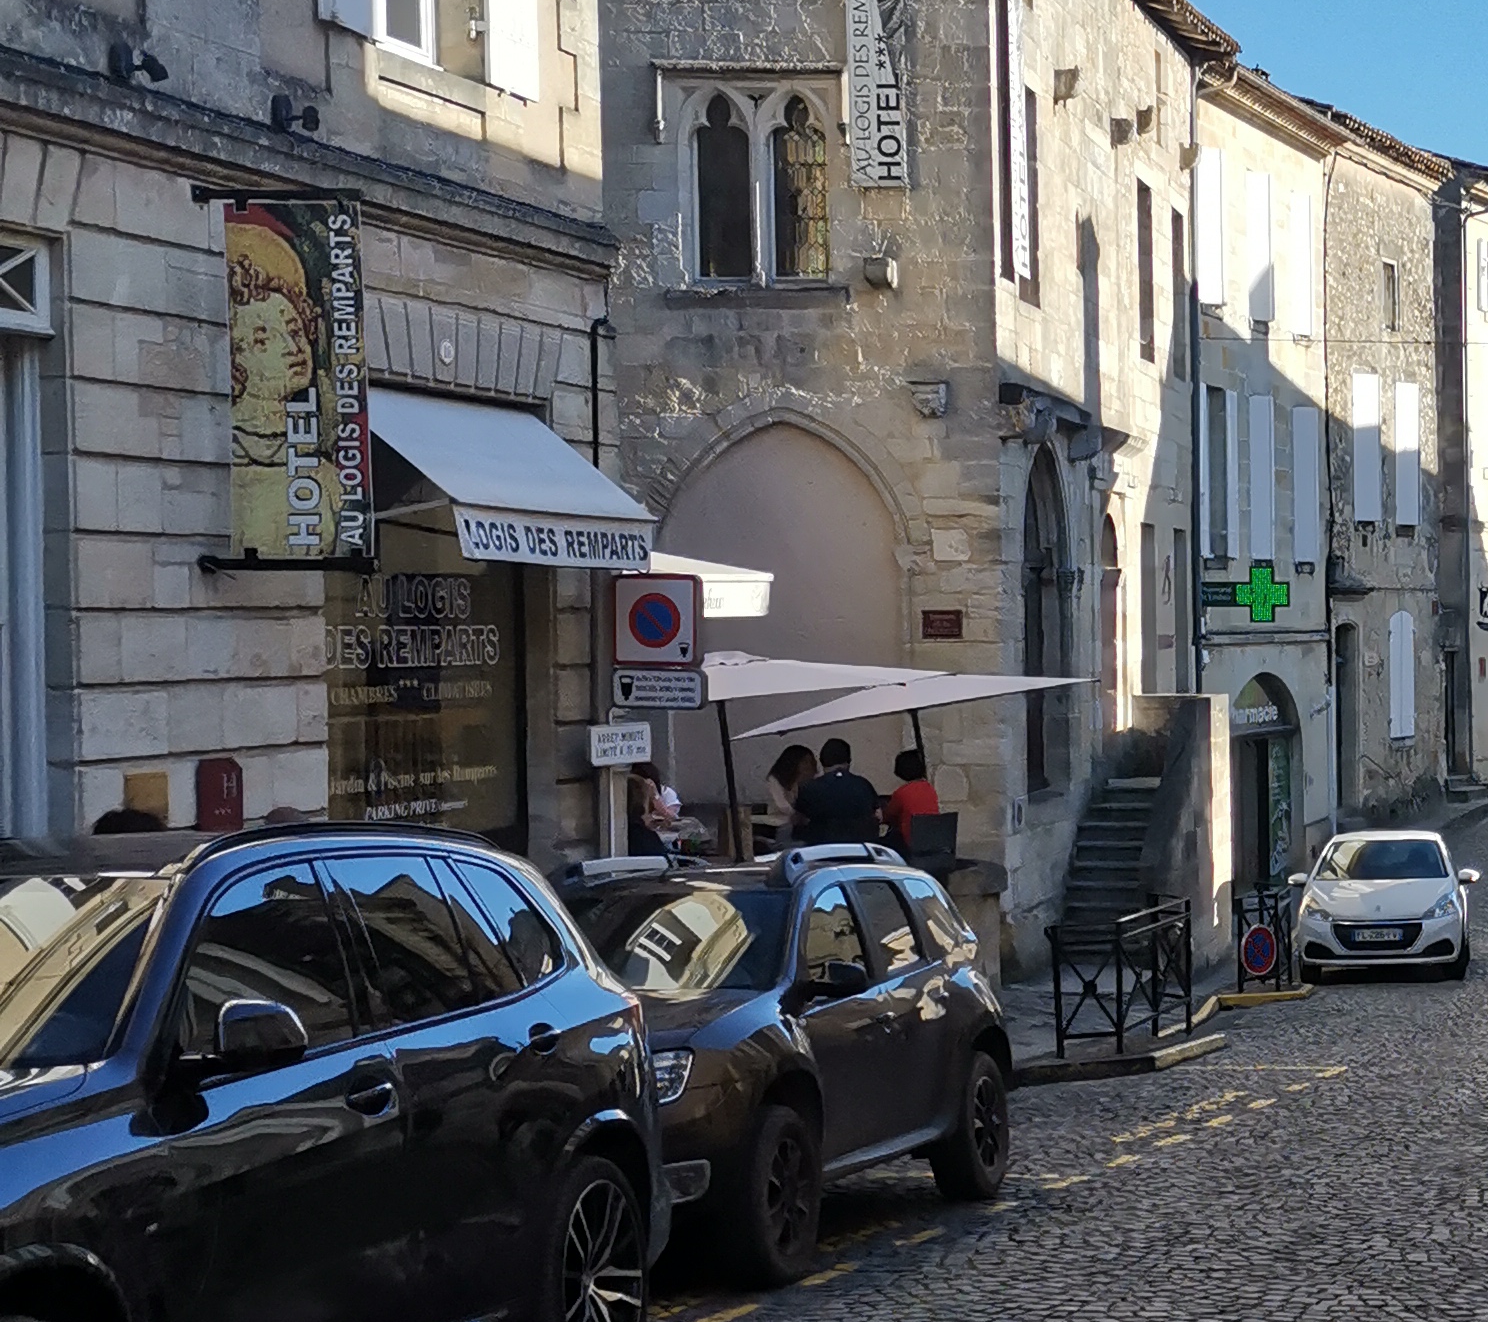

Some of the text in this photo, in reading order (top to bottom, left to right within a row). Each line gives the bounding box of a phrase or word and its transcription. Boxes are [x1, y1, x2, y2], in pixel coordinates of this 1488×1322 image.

[853, 43, 870, 78] DES
[854, 82, 872, 139] LOGIS
[877, 73, 902, 181] HOTEL
[855, 146, 872, 178] AU
[1019, 139, 1029, 269] HOTEL
[329, 213, 364, 546] AU LOGIS DES REMPARTS
[286, 386, 322, 547] HOTEL
[463, 518, 649, 562] LOGIS DES REMPARTS
[355, 574, 472, 619] AU LOGIS
[324, 624, 500, 669] DES REMPARTS
[331, 685, 399, 706] CHAMBRES
[329, 776, 365, 796] Jardin
[367, 773, 377, 792] &
[380, 770, 416, 791] Piscine
[419, 772, 436, 785] sur
[453, 764, 498, 786] Remparts
[364, 801, 408, 822] PARKING
